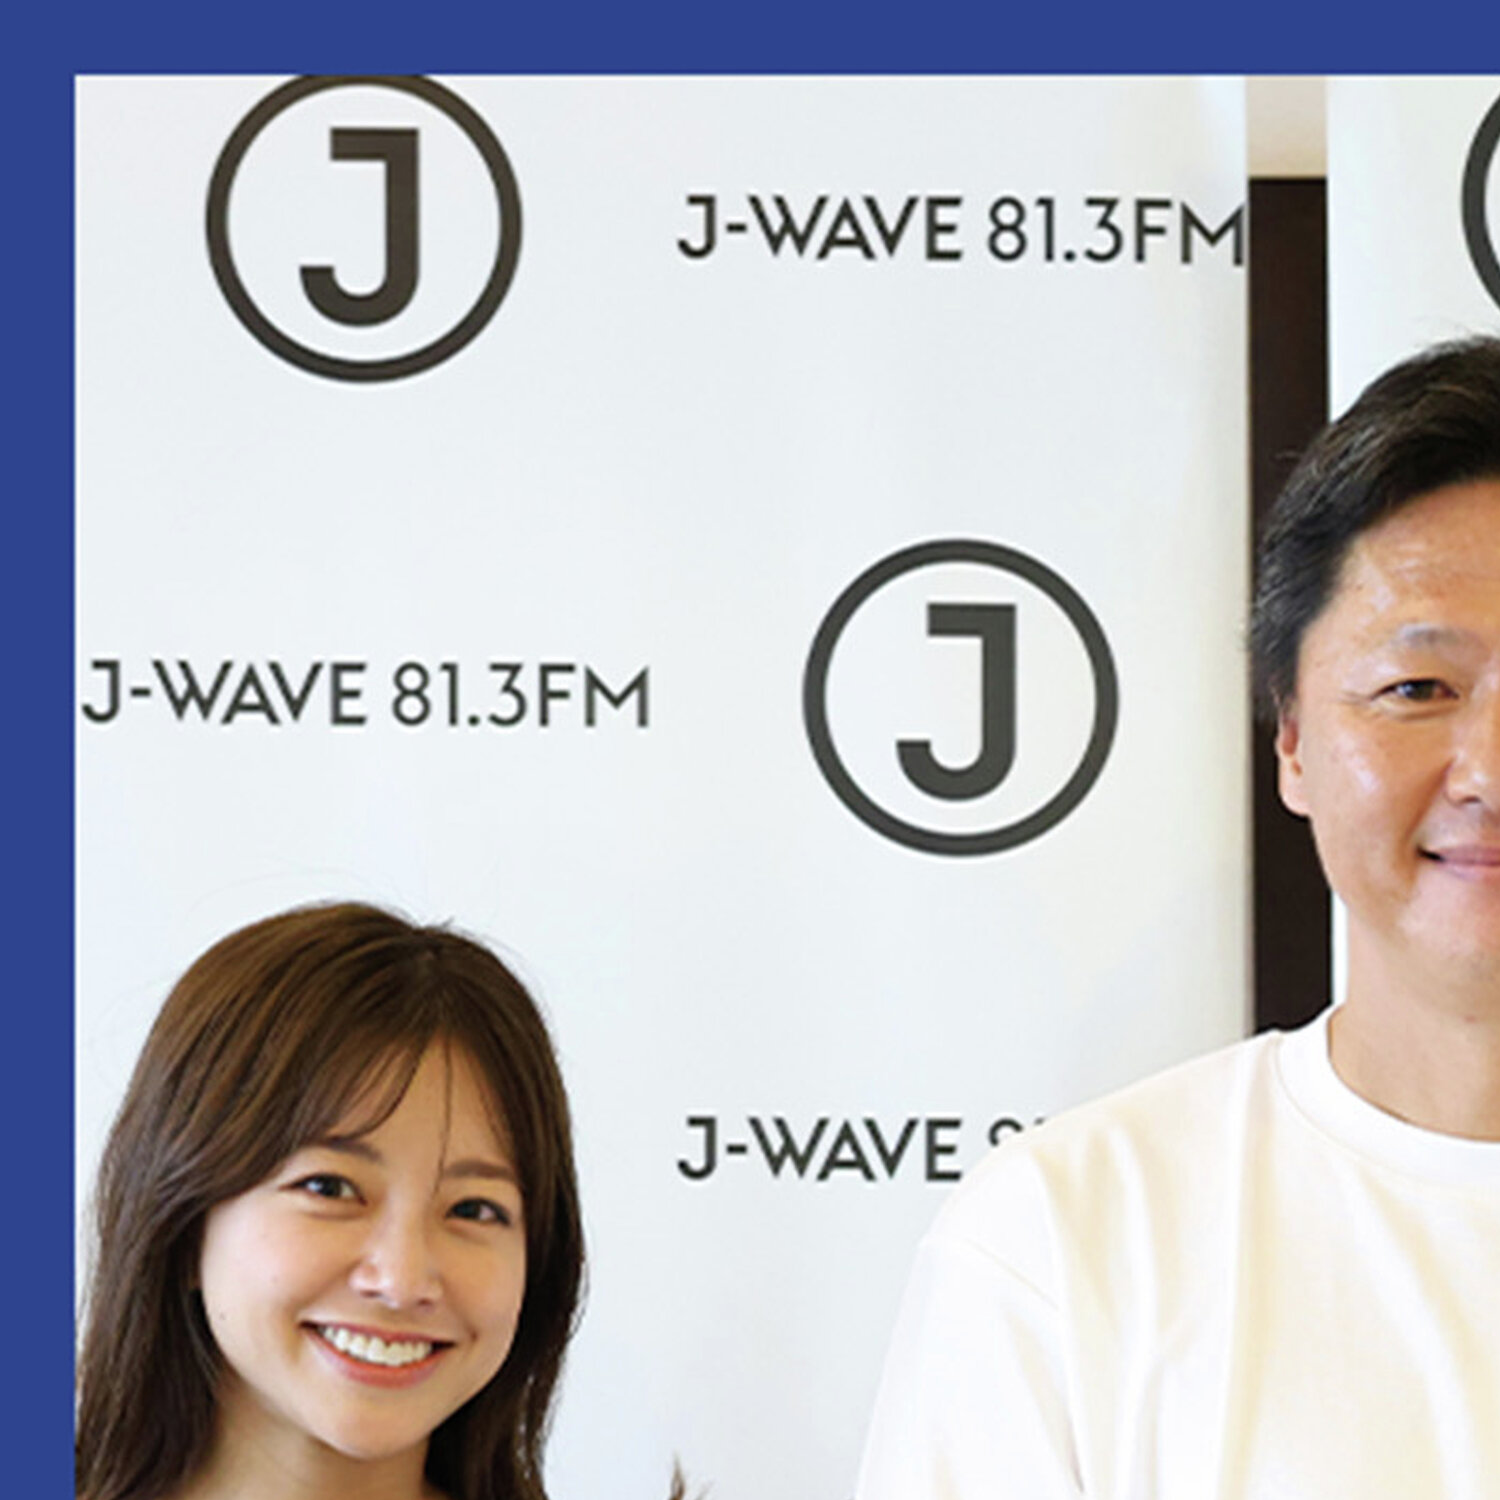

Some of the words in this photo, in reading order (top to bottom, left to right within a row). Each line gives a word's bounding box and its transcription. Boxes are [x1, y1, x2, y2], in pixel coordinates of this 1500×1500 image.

[300, 128, 420, 327] J
[677, 195, 963, 261] J-WAVE
[987, 197, 1246, 267] 81.3FM
[81, 659, 367, 726] J-WAVE
[392, 661, 648, 728] 81.3FM
[896, 602, 1017, 803] J
[677, 1116, 962, 1182] J-WAVE
